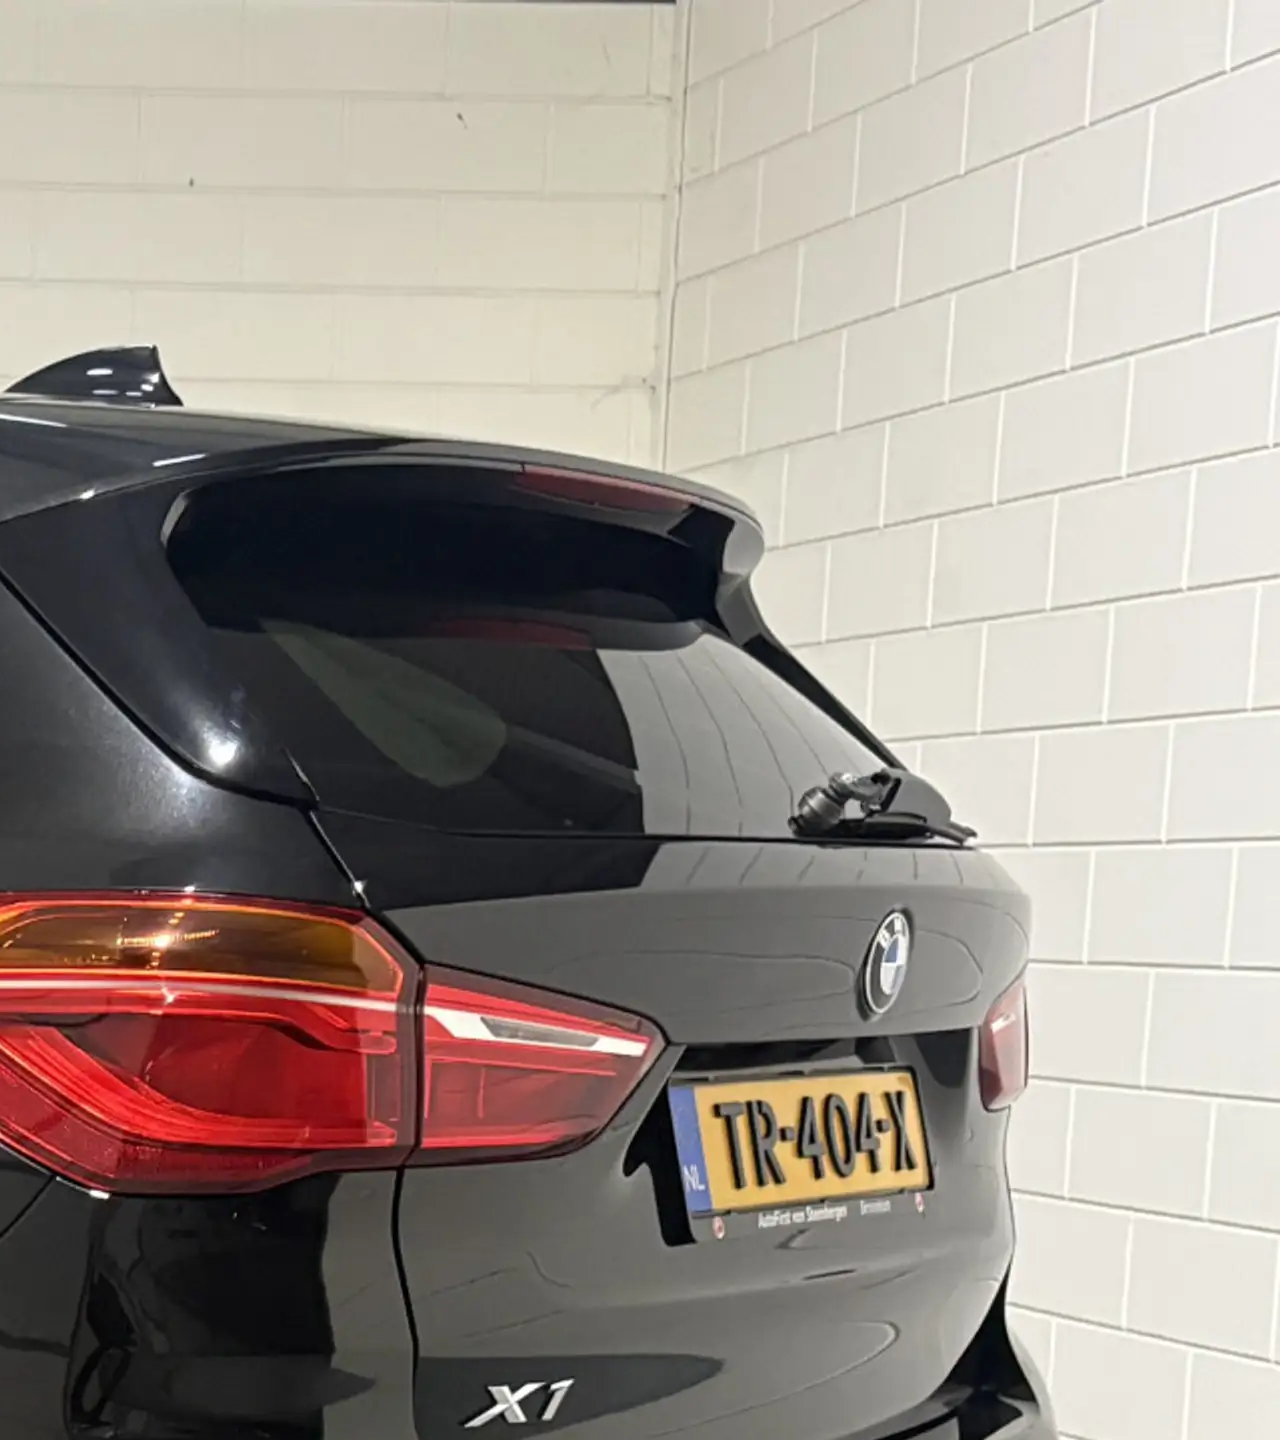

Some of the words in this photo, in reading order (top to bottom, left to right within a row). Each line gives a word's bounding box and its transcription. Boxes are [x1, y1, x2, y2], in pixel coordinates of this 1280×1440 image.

[713, 1090, 916, 1189] TR-404-X
[683, 1166, 706, 1192] NL
[464, 1379, 574, 1428] X1
